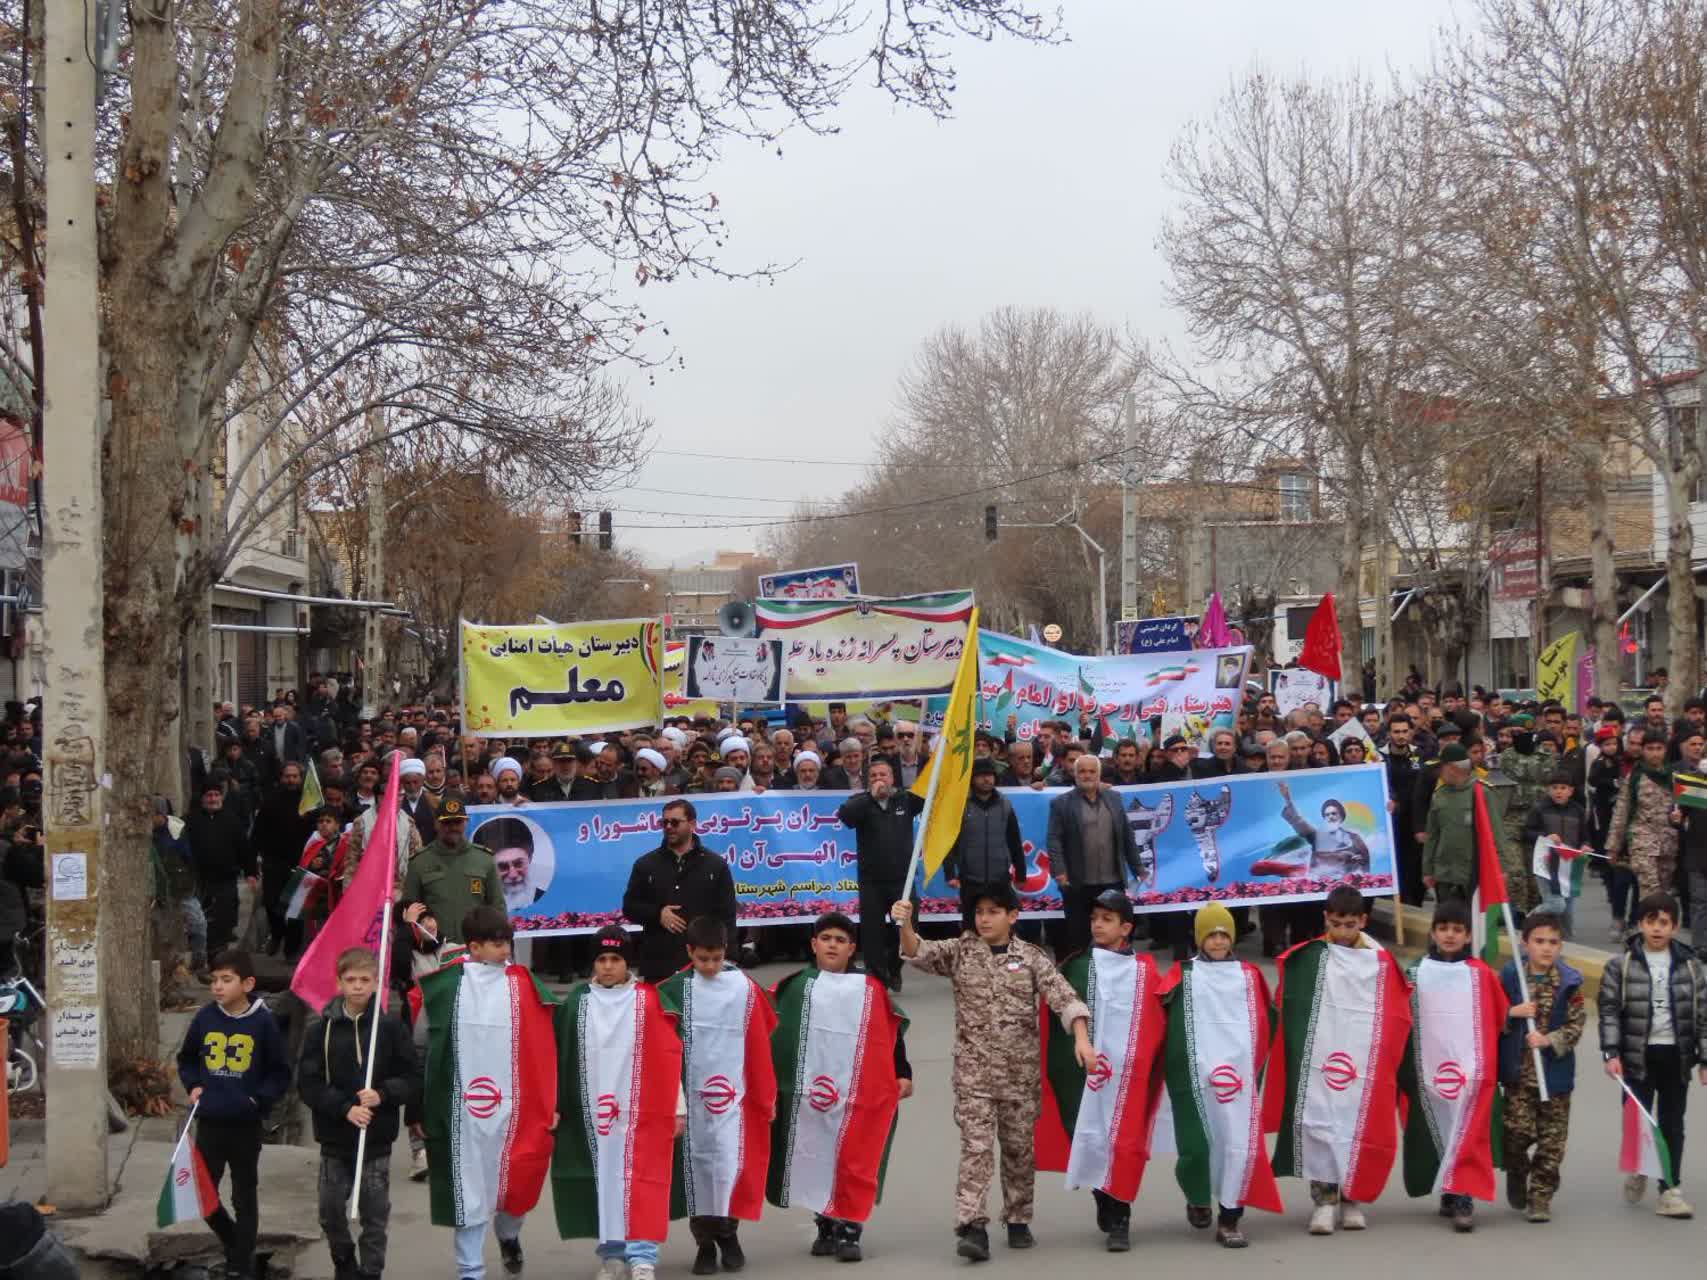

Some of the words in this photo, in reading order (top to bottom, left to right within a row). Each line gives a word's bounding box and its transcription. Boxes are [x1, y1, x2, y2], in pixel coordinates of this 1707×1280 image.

[490, 637, 533, 658] امنایی
[579, 636, 639, 658] دبیرستان
[808, 639, 826, 675] یاد
[826, 637, 855, 662] زنده
[858, 632, 898, 663] پسرانه
[904, 627, 964, 663] دبیرستان
[509, 664, 625, 718] معلم
[1015, 681, 1053, 708] امام
[1172, 694, 1233, 717] هنرستا
[788, 803, 842, 831] یران
[576, 823, 590, 844] و
[740, 839, 767, 870] آن
[767, 840, 836, 869] الهی
[735, 880, 787, 898] شهرستا
[790, 880, 833, 898] مراسم
[204, 1031, 255, 1073] 33
